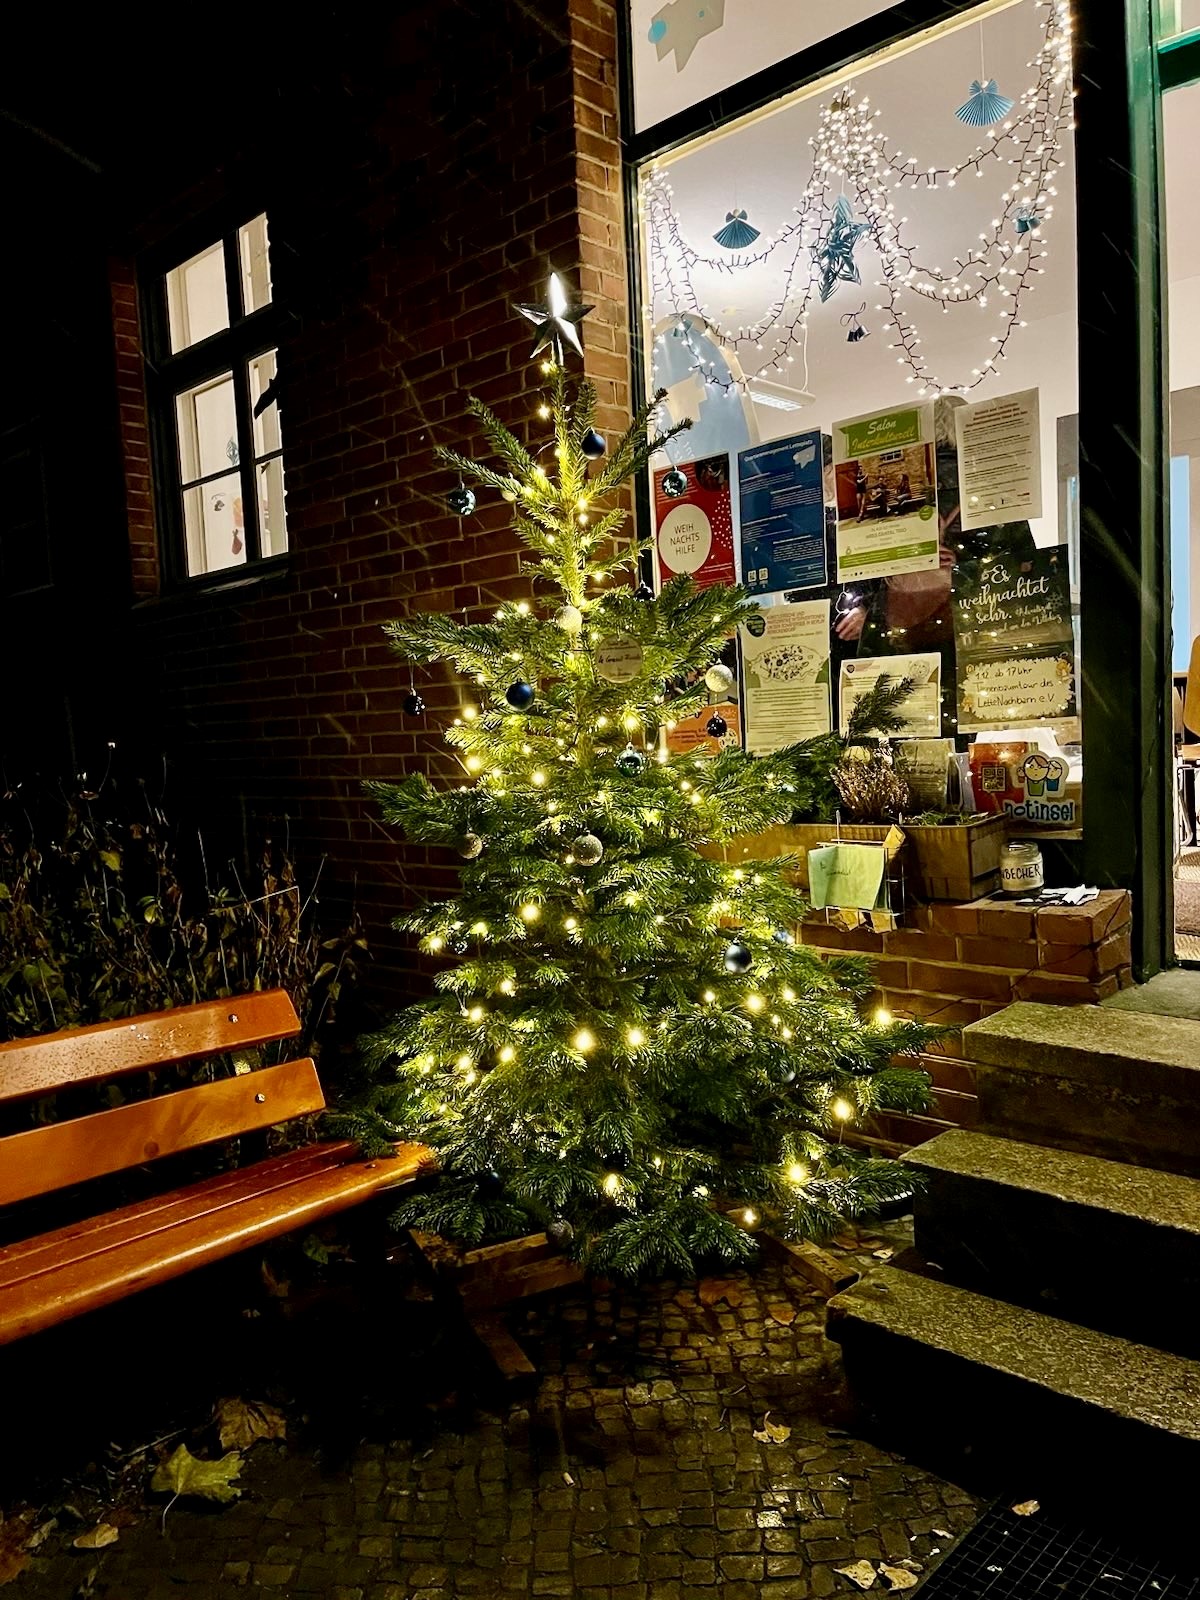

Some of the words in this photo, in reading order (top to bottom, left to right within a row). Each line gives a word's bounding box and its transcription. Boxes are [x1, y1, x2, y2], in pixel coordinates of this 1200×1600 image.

[867, 418, 897, 434] Salon
[674, 523, 694, 534] WEIH
[670, 532, 700, 546] NACHTS
[676, 544, 695, 555] HILFE
[981, 564, 1011, 584] Es
[959, 576, 1049, 610] weihnachtet
[976, 600, 1012, 624] sehr.
[995, 668, 1004, 678] ab
[1007, 666, 1017, 676] 17
[1017, 667, 1033, 676] Uhr
[1004, 800, 1074, 821] notinsel
